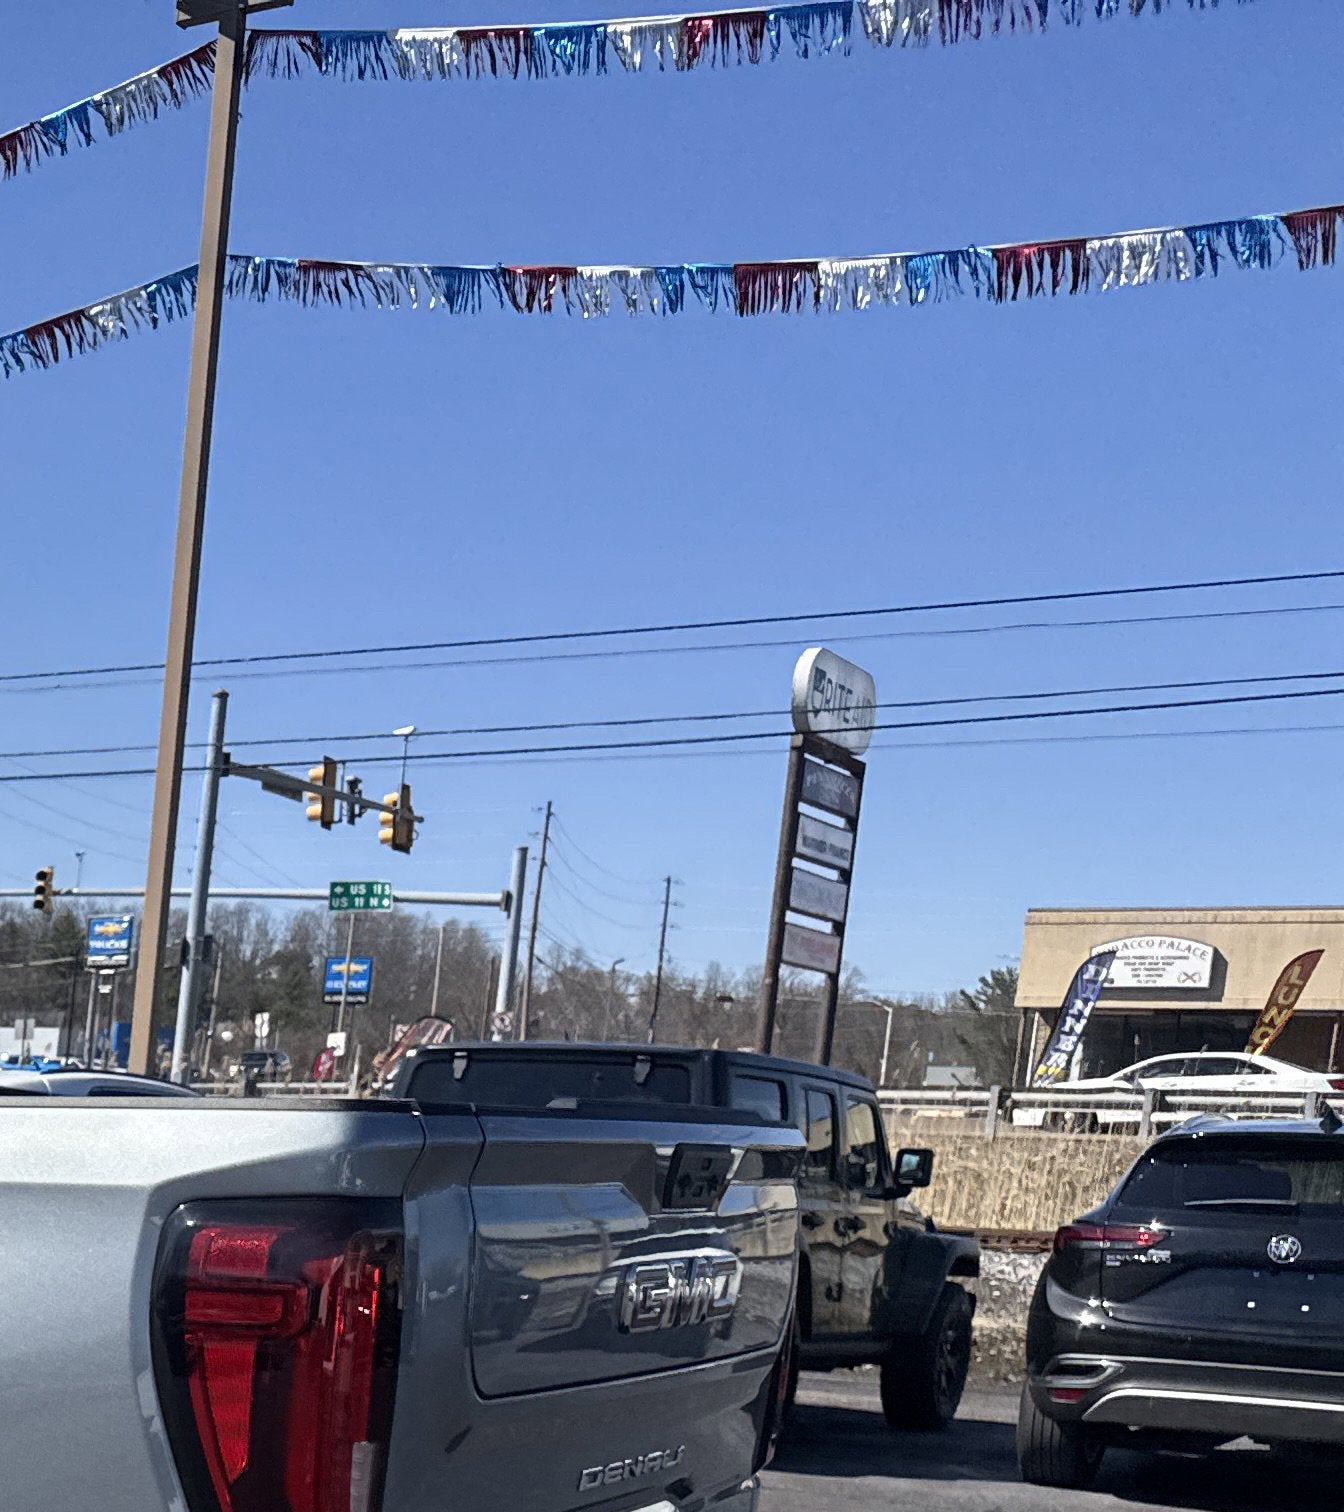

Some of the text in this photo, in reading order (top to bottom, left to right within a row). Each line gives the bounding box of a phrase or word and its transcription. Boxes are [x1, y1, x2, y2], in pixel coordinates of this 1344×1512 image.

[349, 884, 367, 895] US
[373, 884, 382, 895] 11
[332, 897, 379, 908] US 11 N
[1158, 939, 1210, 961] PALACE
[620, 1256, 744, 1334] GMC
[577, 1444, 686, 1492] DENALI
